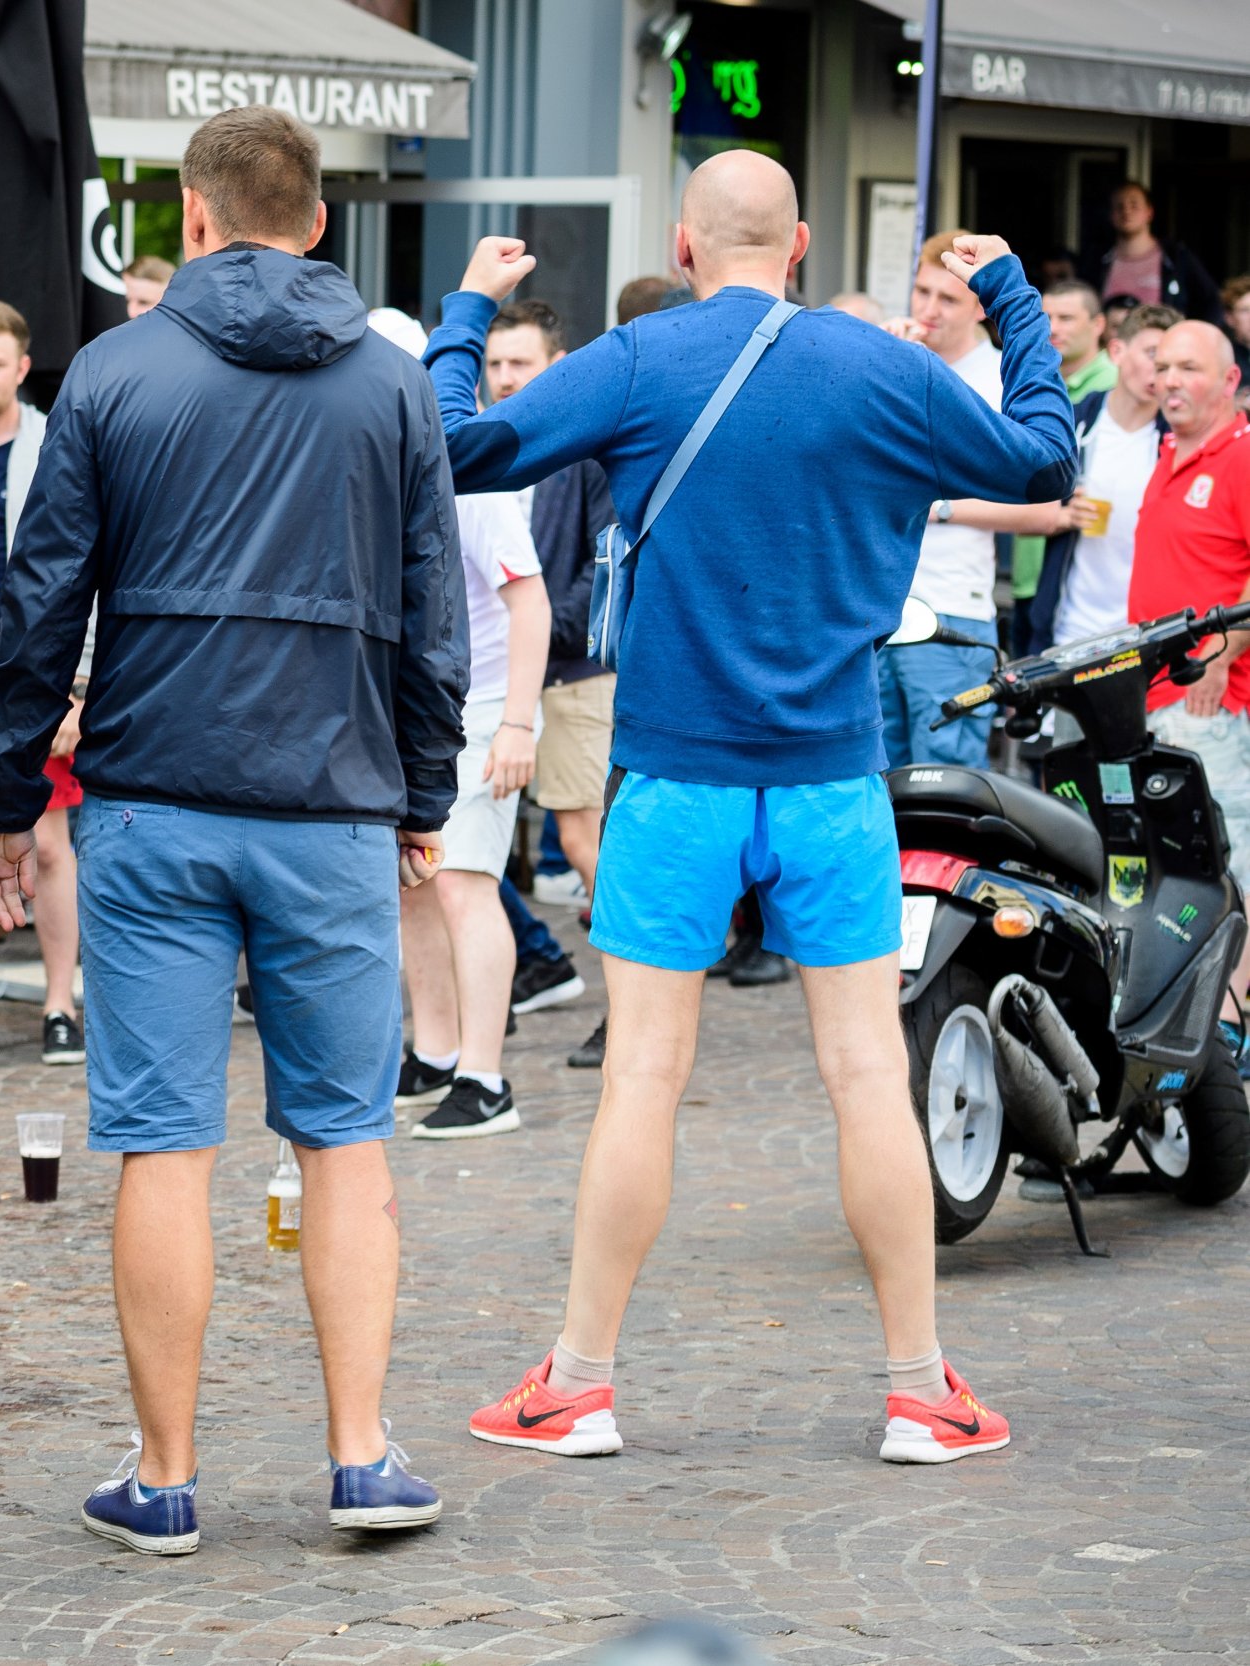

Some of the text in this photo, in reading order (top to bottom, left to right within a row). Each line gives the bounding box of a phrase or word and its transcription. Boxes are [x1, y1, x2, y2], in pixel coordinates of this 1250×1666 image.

[972, 53, 1026, 96] BAR
[166, 68, 434, 130] RESTAURANT
[909, 769, 944, 783] MBK
